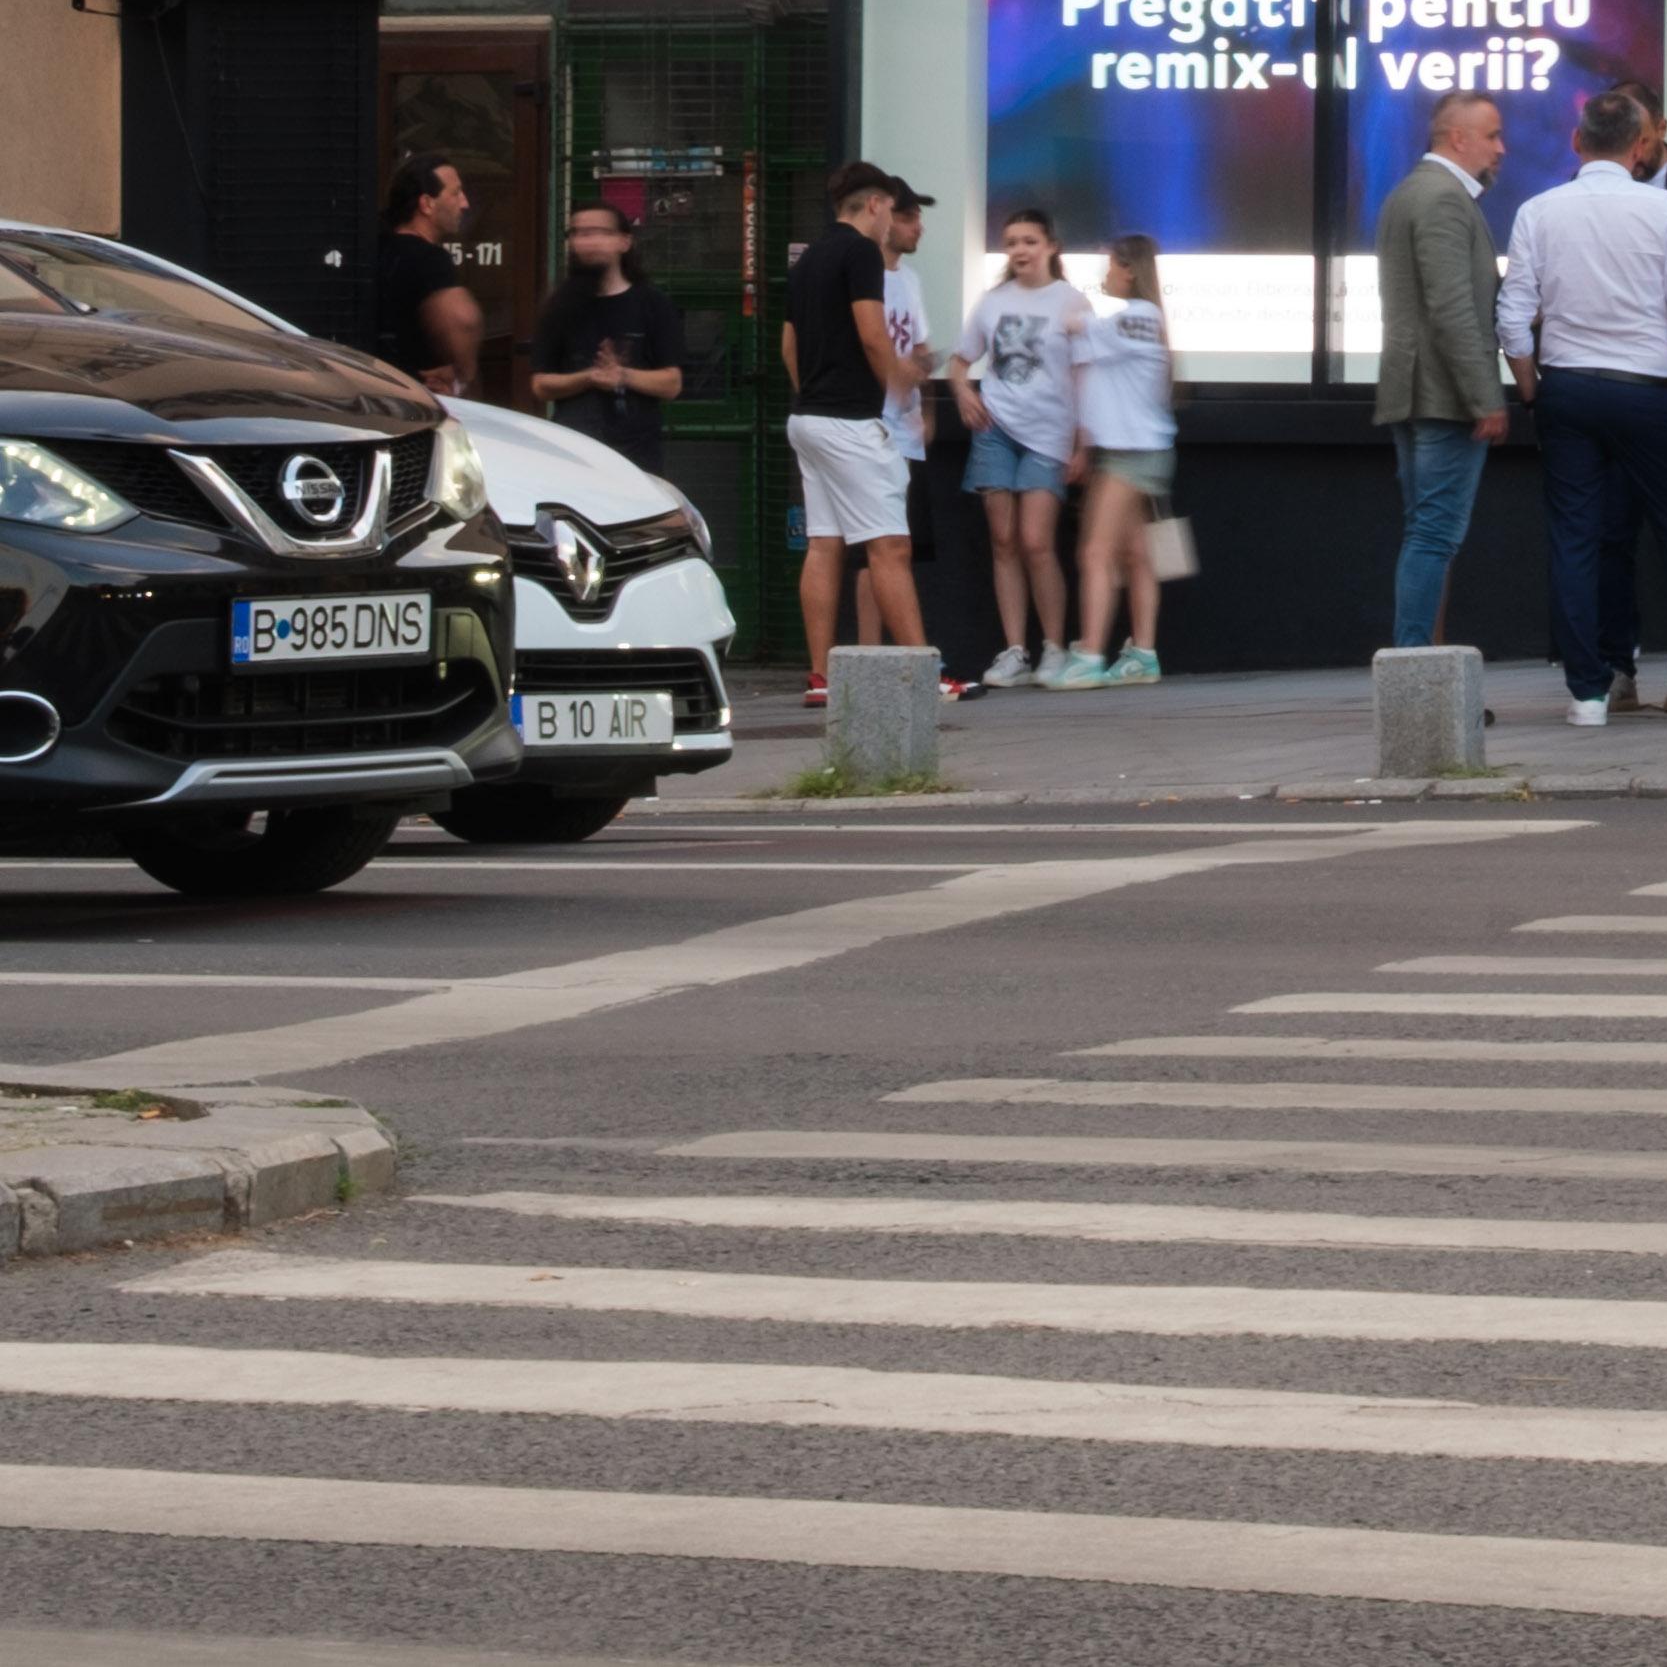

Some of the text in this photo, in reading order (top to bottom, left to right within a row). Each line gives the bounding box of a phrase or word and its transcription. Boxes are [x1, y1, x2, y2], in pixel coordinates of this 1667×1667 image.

[1378, 36, 1560, 91] verii?
[476, 242, 502, 265] 171
[254, 609, 276, 654] B
[290, 605, 348, 651] 985
[354, 601, 423, 648] DNS
[538, 699, 647, 739] B 10 AIR
